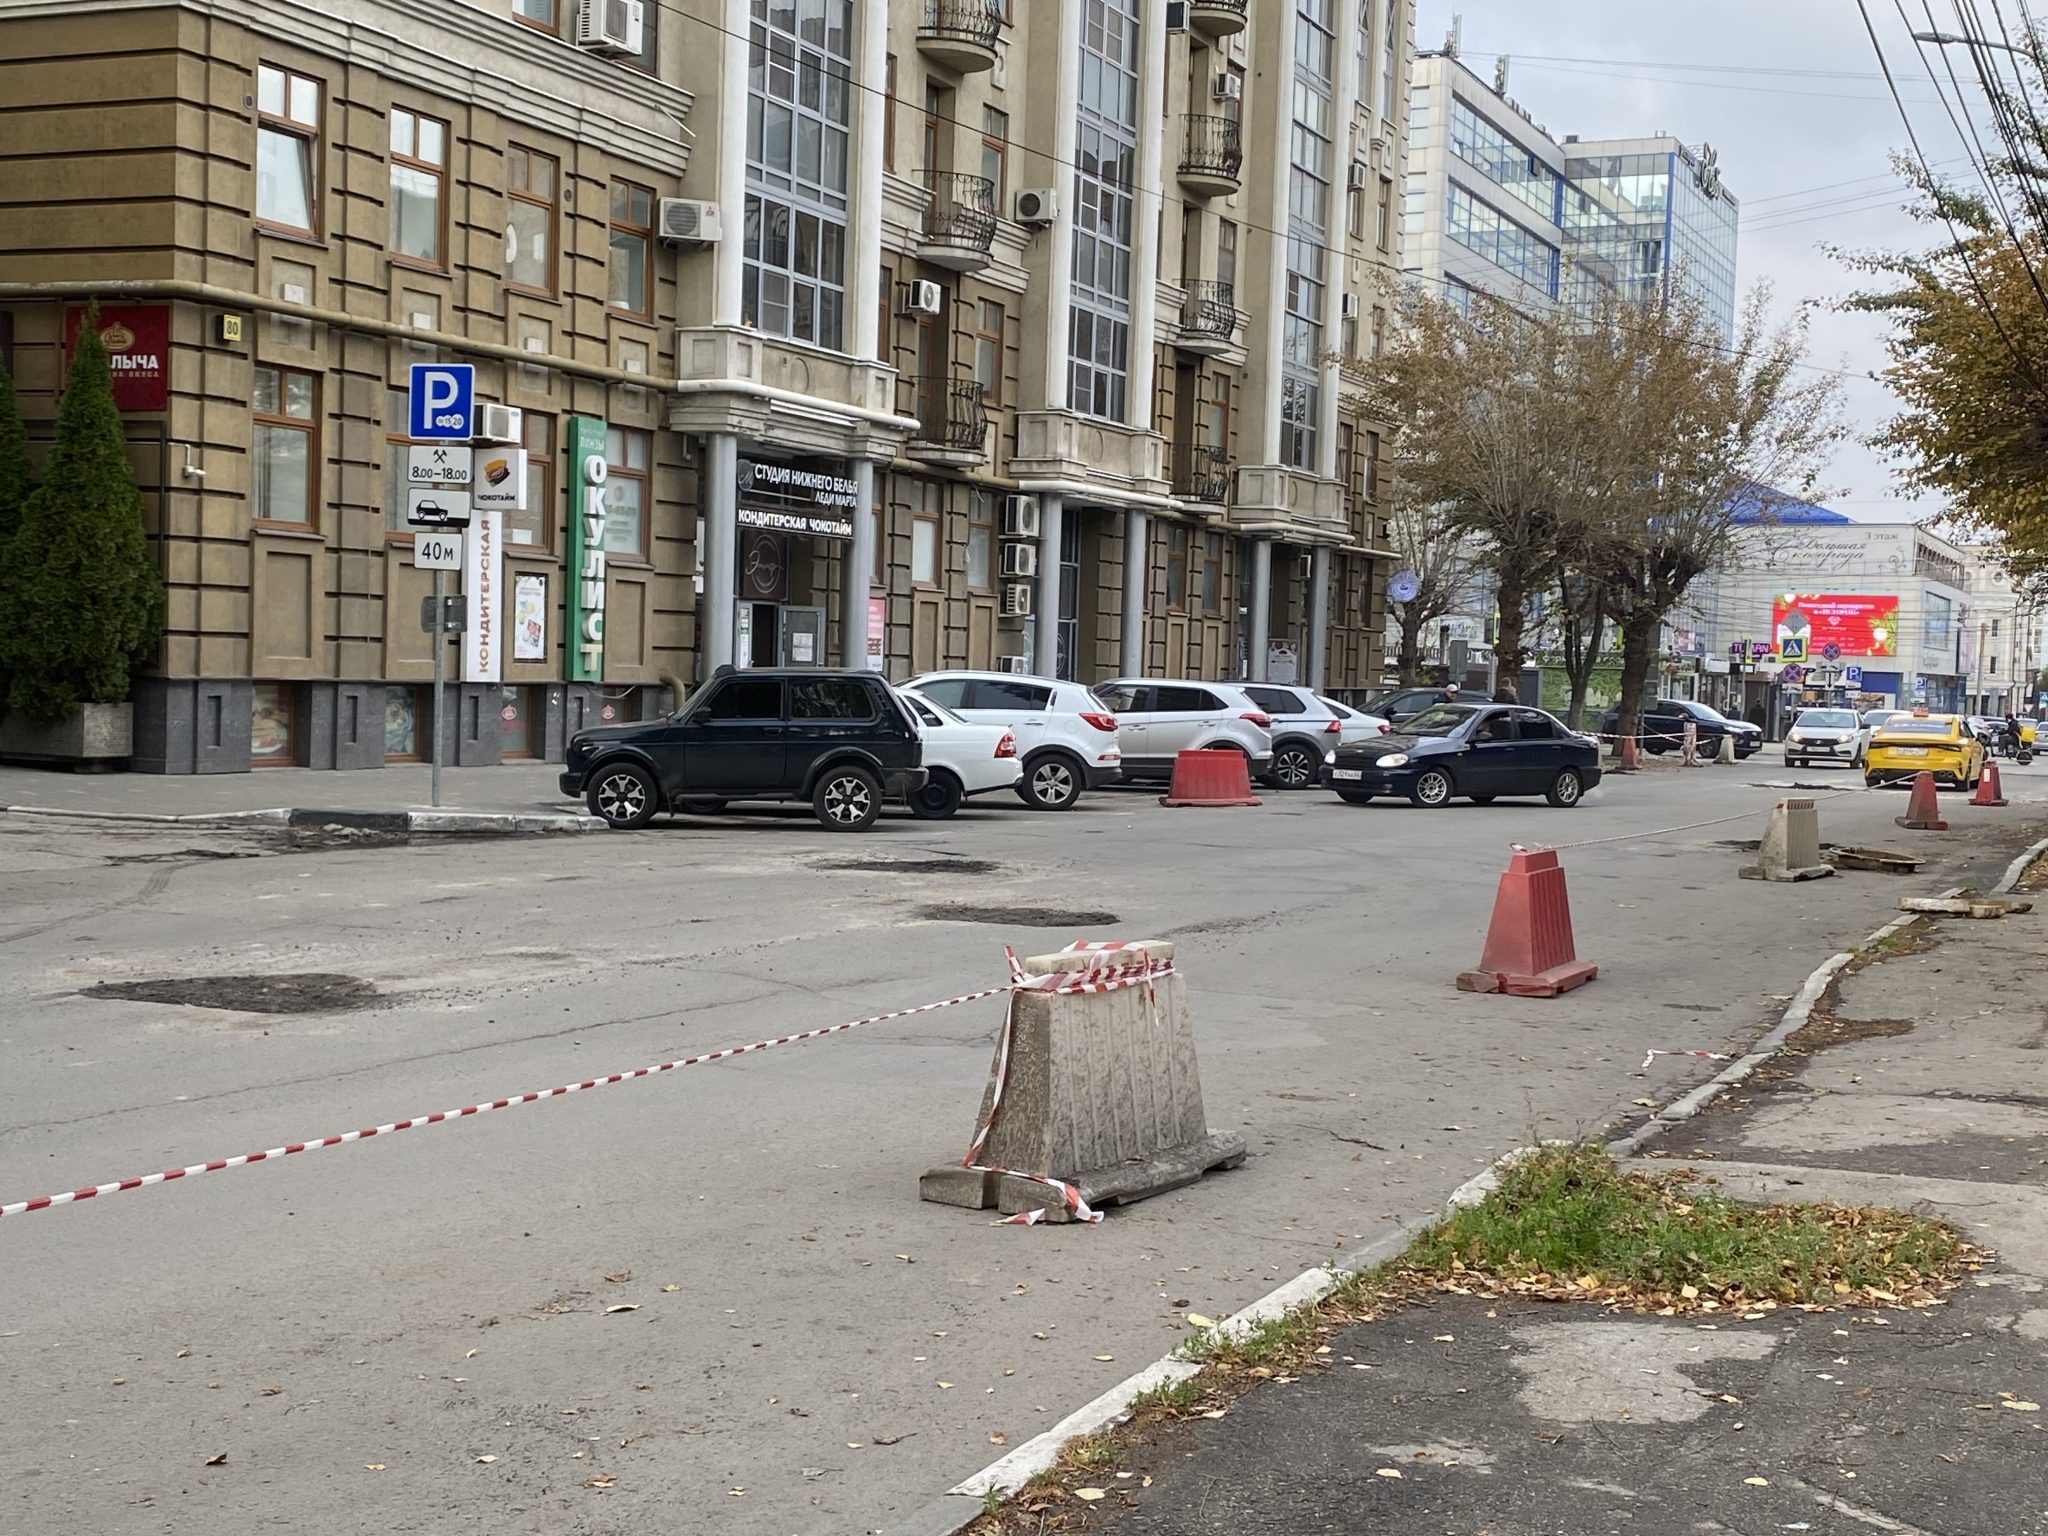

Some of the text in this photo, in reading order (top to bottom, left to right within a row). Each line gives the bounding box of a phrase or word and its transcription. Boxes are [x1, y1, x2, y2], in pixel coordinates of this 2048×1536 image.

[226, 320, 239, 336] 80
[111, 354, 159, 369] ЛЫЧА
[423, 371, 460, 430] P
[452, 417, 463, 426] 20
[754, 463, 859, 495] СТУДИЯ НИЖНЕГО БЕЛЬЯ
[477, 492, 516, 502] ЧОКОТАЙМ
[814, 491, 858, 508] ЛЕДИ МАРТА
[737, 509, 852, 536] КОНДИТЕРСКАЯ ЧОКОТАЙМ
[580, 454, 608, 673] ОКУЛИСТ
[478, 519, 491, 673] КОНДИТЕРСКАЯ
[1734, 643, 1769, 653] TAN
